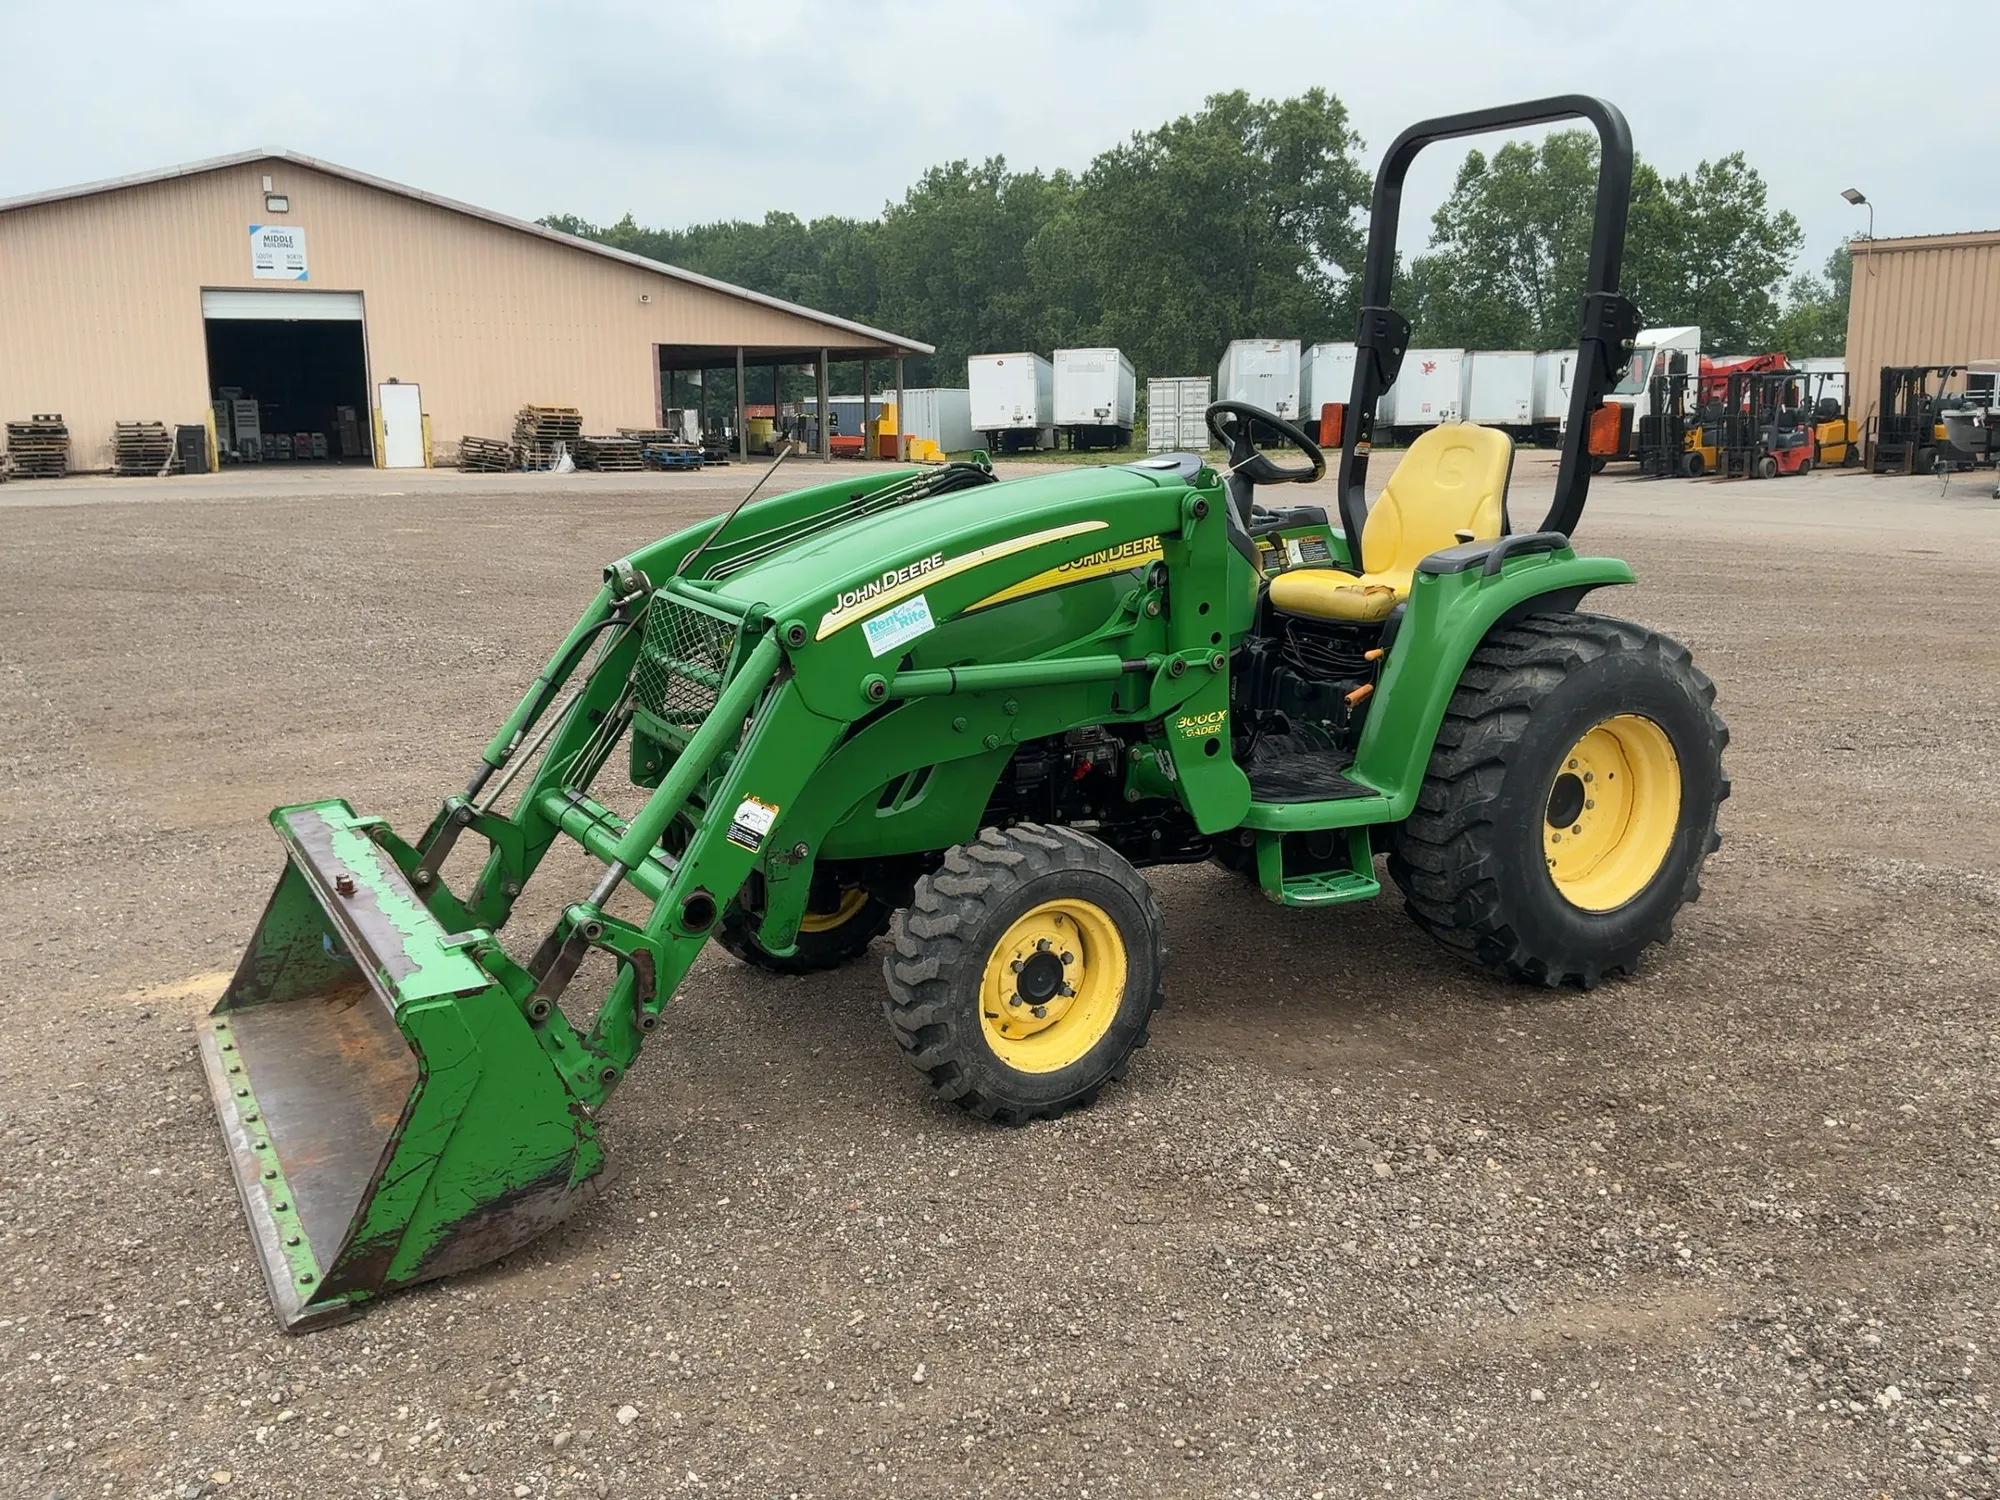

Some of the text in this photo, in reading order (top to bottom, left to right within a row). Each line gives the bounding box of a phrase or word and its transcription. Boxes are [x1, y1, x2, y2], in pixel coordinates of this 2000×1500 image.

[263, 235, 293, 243] MIDDLE
[1109, 535, 1162, 562] DEERE
[831, 551, 944, 615] JOHN DEERE
[867, 612, 900, 635] Rent
[899, 609, 927, 629] Rite
[1182, 724, 1222, 740] OADER
